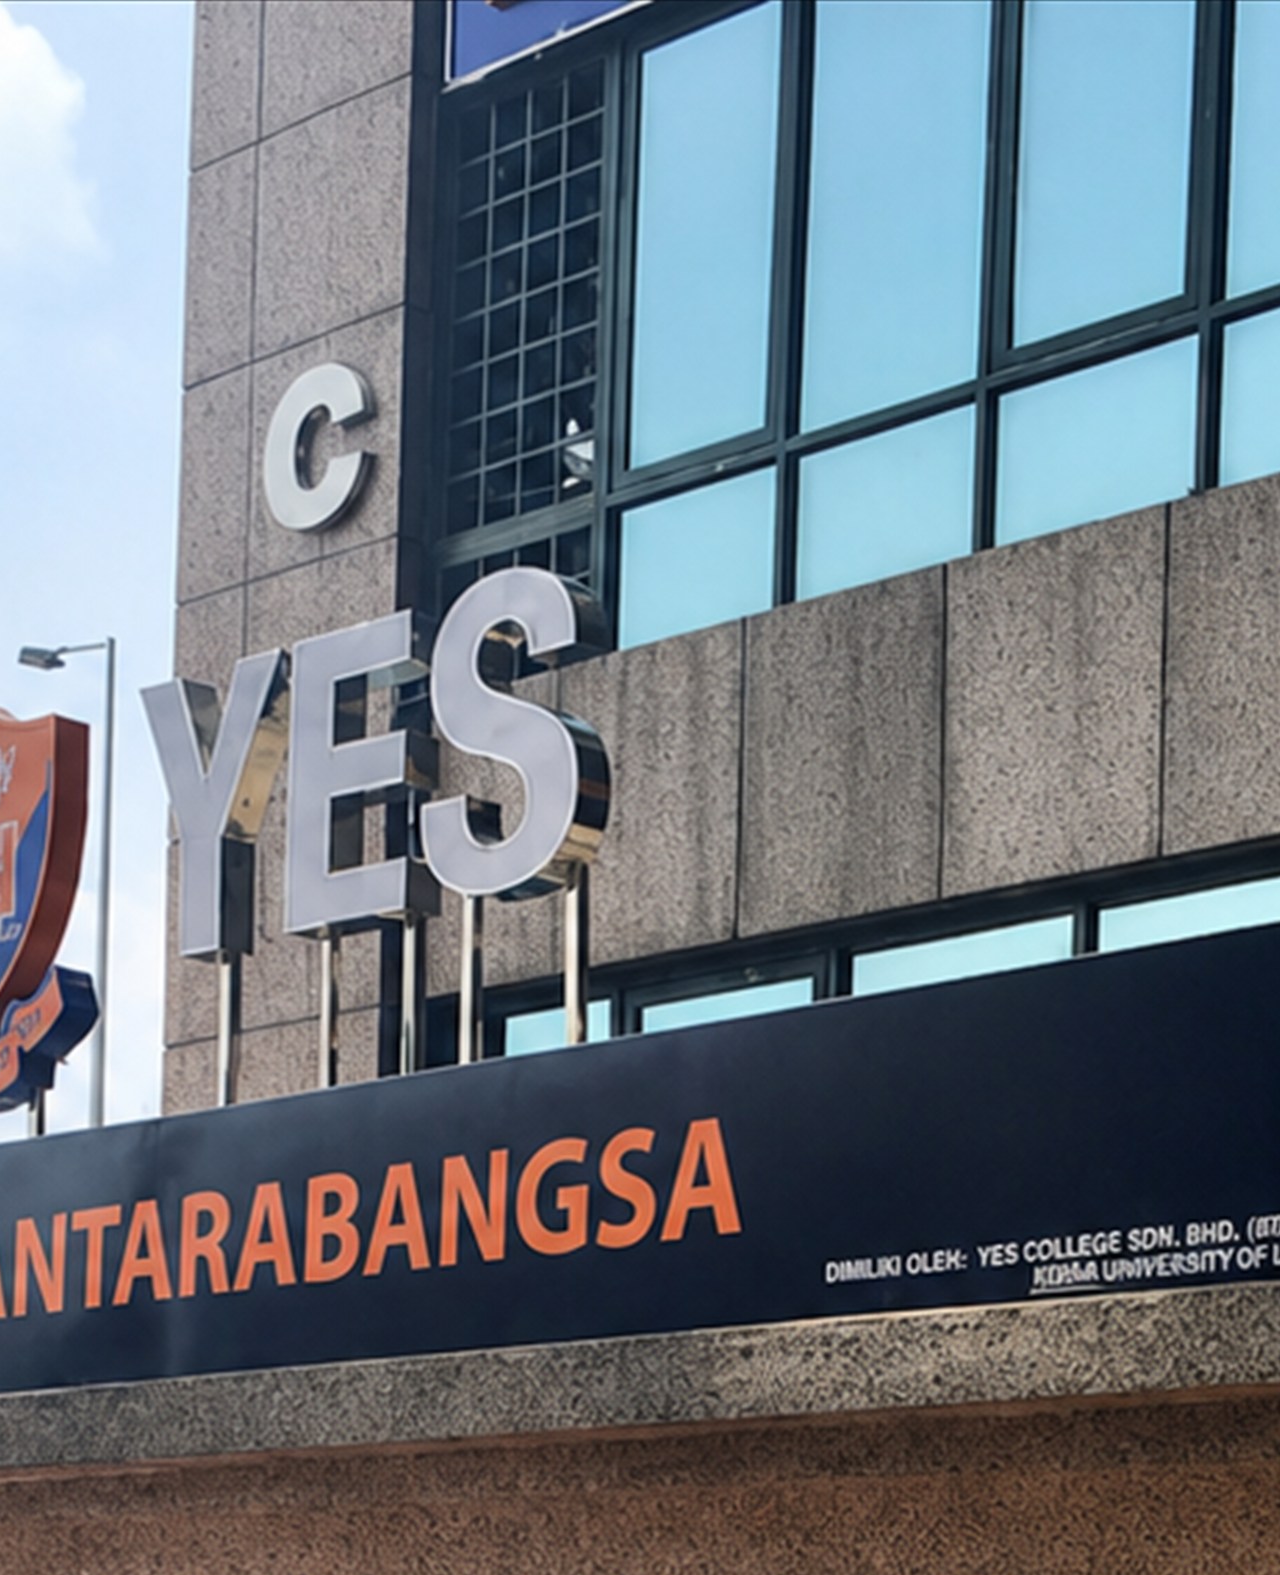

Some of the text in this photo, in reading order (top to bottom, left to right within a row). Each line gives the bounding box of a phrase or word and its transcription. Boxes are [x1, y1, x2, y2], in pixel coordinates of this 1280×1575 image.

[263, 361, 375, 530] C
[139, 565, 595, 960] YES
[904, 1248, 969, 1275] OLEH:
[977, 1241, 1019, 1268] YES
[1022, 1229, 1122, 1263] COLLEGE
[1126, 1224, 1182, 1253] SDN.
[1185, 1218, 1241, 1247] BHD.
[1101, 1245, 1235, 1283] UNIVERSITY
[1235, 1243, 1268, 1271] OF
